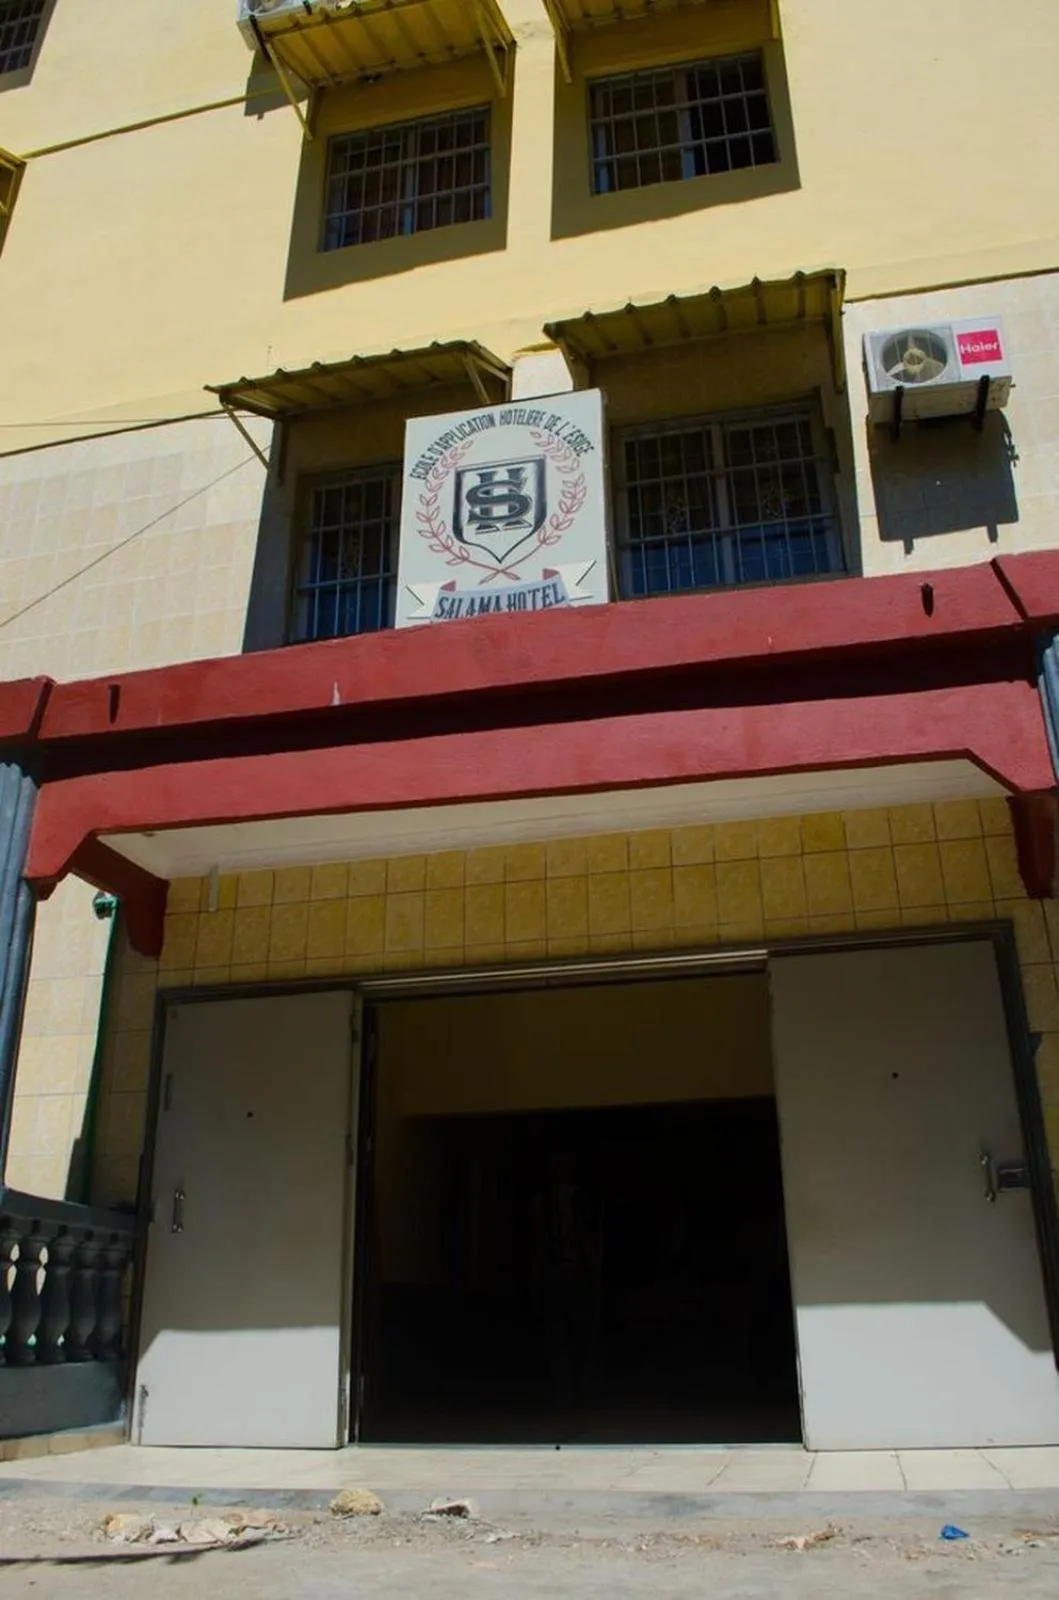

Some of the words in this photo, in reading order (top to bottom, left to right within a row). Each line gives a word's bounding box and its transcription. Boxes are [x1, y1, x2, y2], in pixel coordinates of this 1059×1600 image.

[960, 341, 998, 354] Haier
[409, 453, 440, 480] ECOLE
[543, 413, 562, 432] DE
[434, 594, 501, 620] SALAMA
[506, 583, 566, 613] HOTEL
